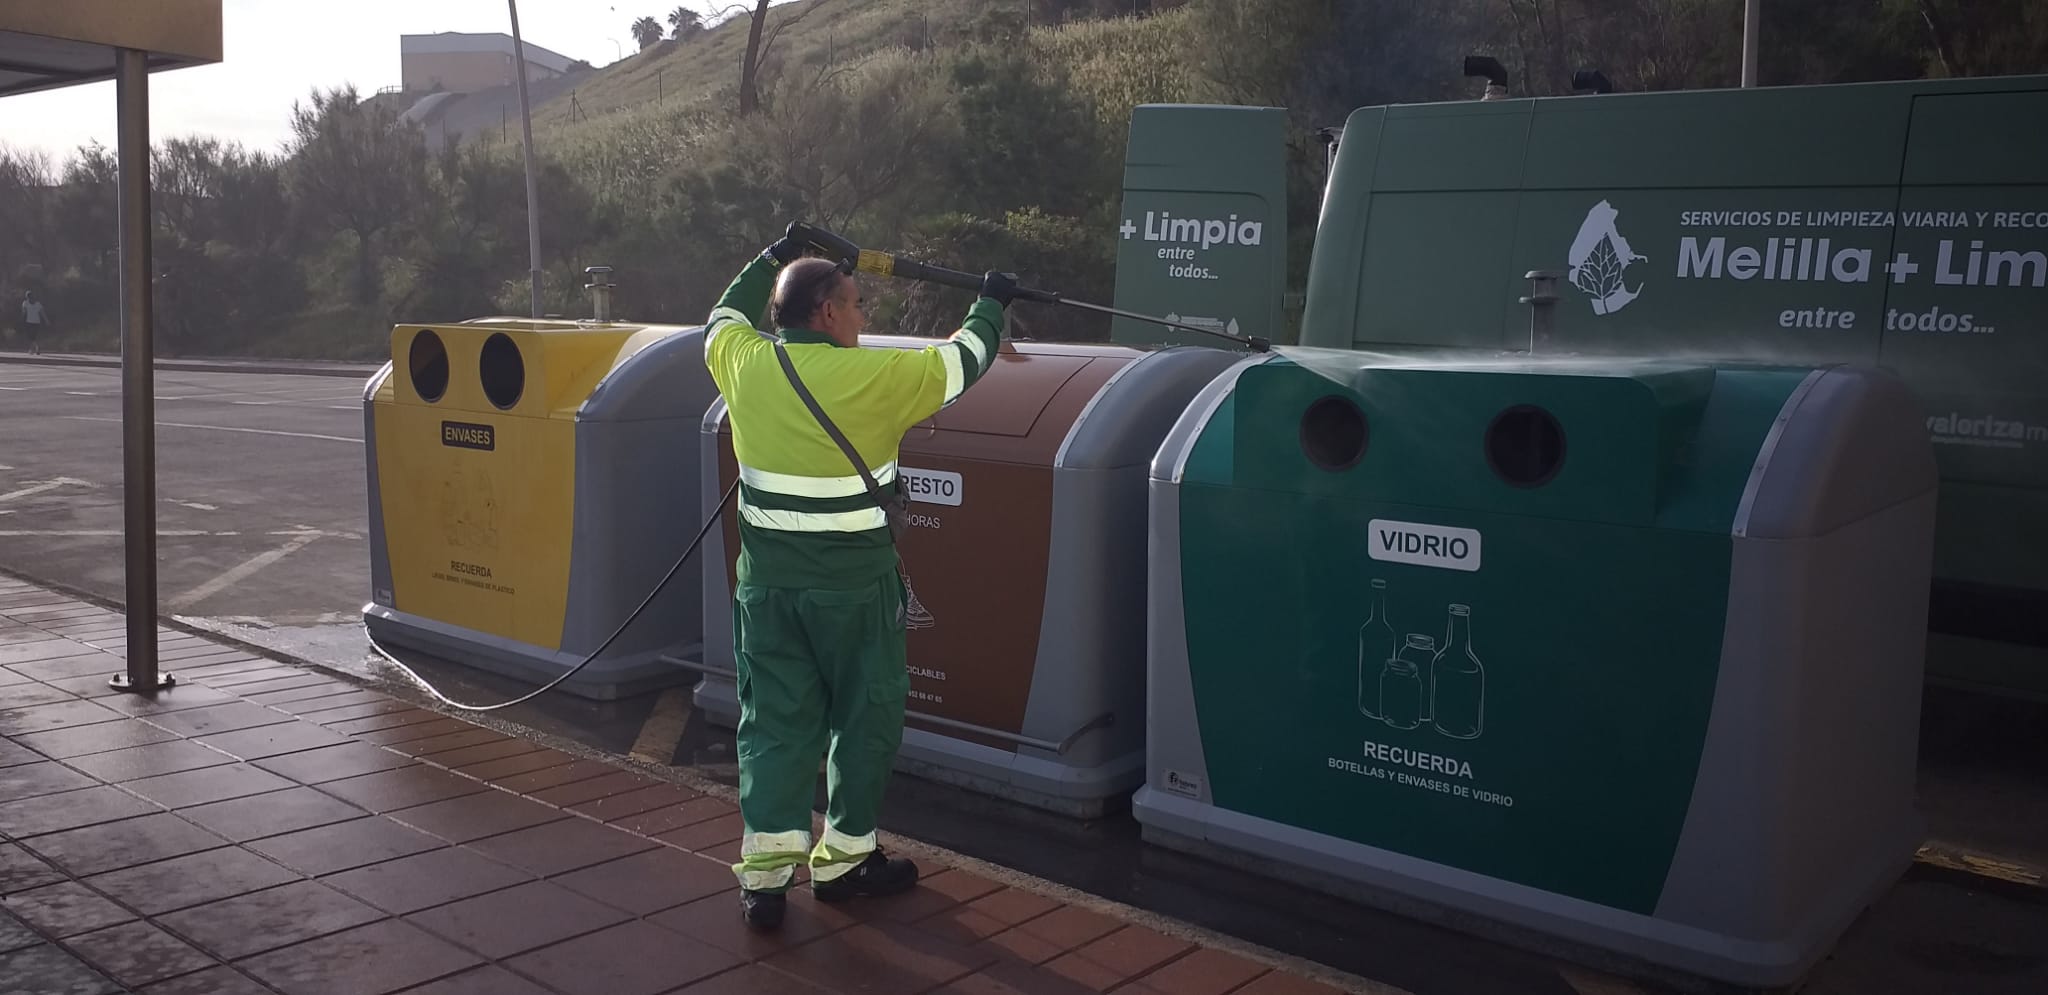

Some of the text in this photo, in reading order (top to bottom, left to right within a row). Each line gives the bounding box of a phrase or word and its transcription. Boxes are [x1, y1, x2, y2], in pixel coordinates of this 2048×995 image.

[1144, 211, 1262, 250] Limpia
[1680, 211, 2048, 228] SERVICIOS DE LIMPIEZA VIARIA Y RECO
[1158, 247, 1195, 260] entre
[1677, 237, 1872, 282] Melilla
[1935, 240, 2048, 287] Lim
[1779, 307, 1855, 329] entre
[445, 426, 490, 445] ENVASES
[1380, 530, 1469, 559] VIDRIO
[450, 560, 492, 578] RECUERDA
[1364, 741, 1473, 779] RECUERDA
[1328, 757, 1513, 807] BOTELLAS Y ENVASES DE VIDRIO
